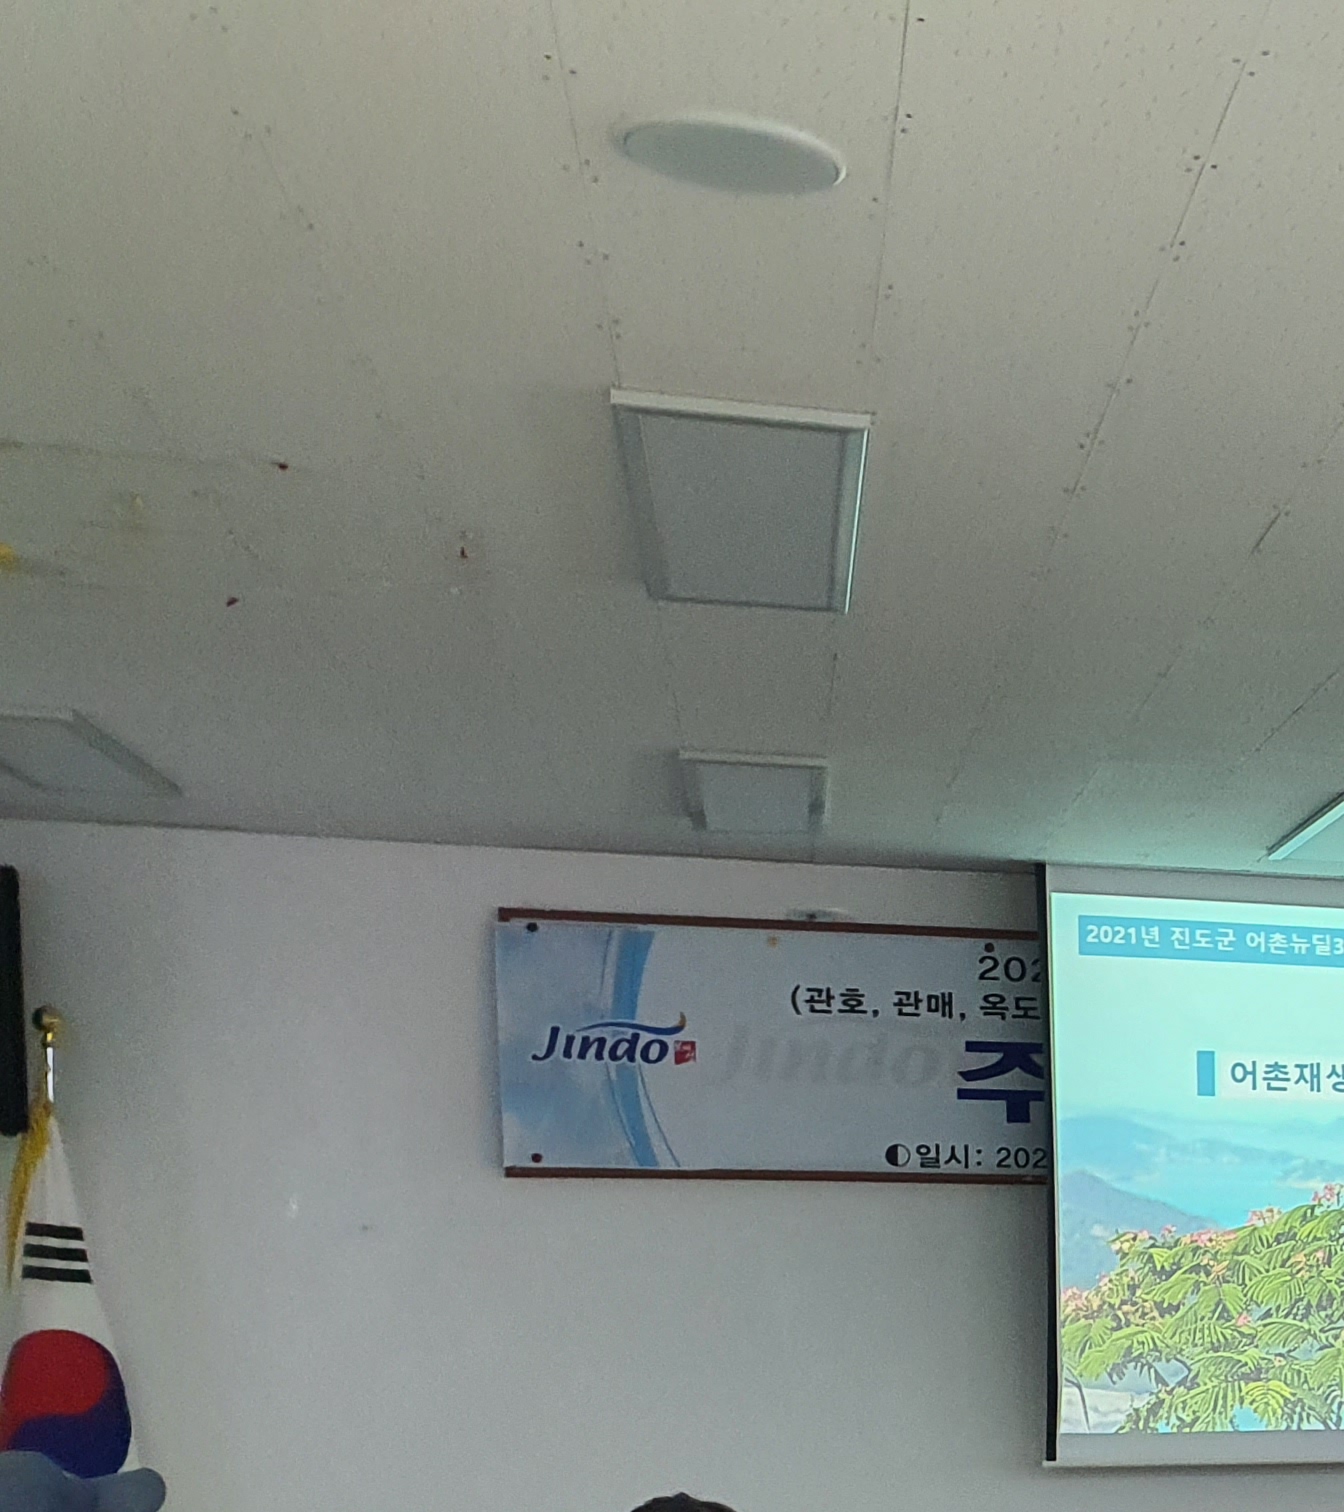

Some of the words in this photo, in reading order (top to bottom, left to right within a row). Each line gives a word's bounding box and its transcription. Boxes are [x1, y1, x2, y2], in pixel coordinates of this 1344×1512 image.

[1085, 924, 1161, 948] 2021년
[1170, 926, 1237, 951] 진도군
[791, 984, 880, 1018] (관호,
[893, 990, 966, 1022] 관매,
[979, 993, 1042, 1021] 옥도
[531, 1025, 670, 1064] Jindo
